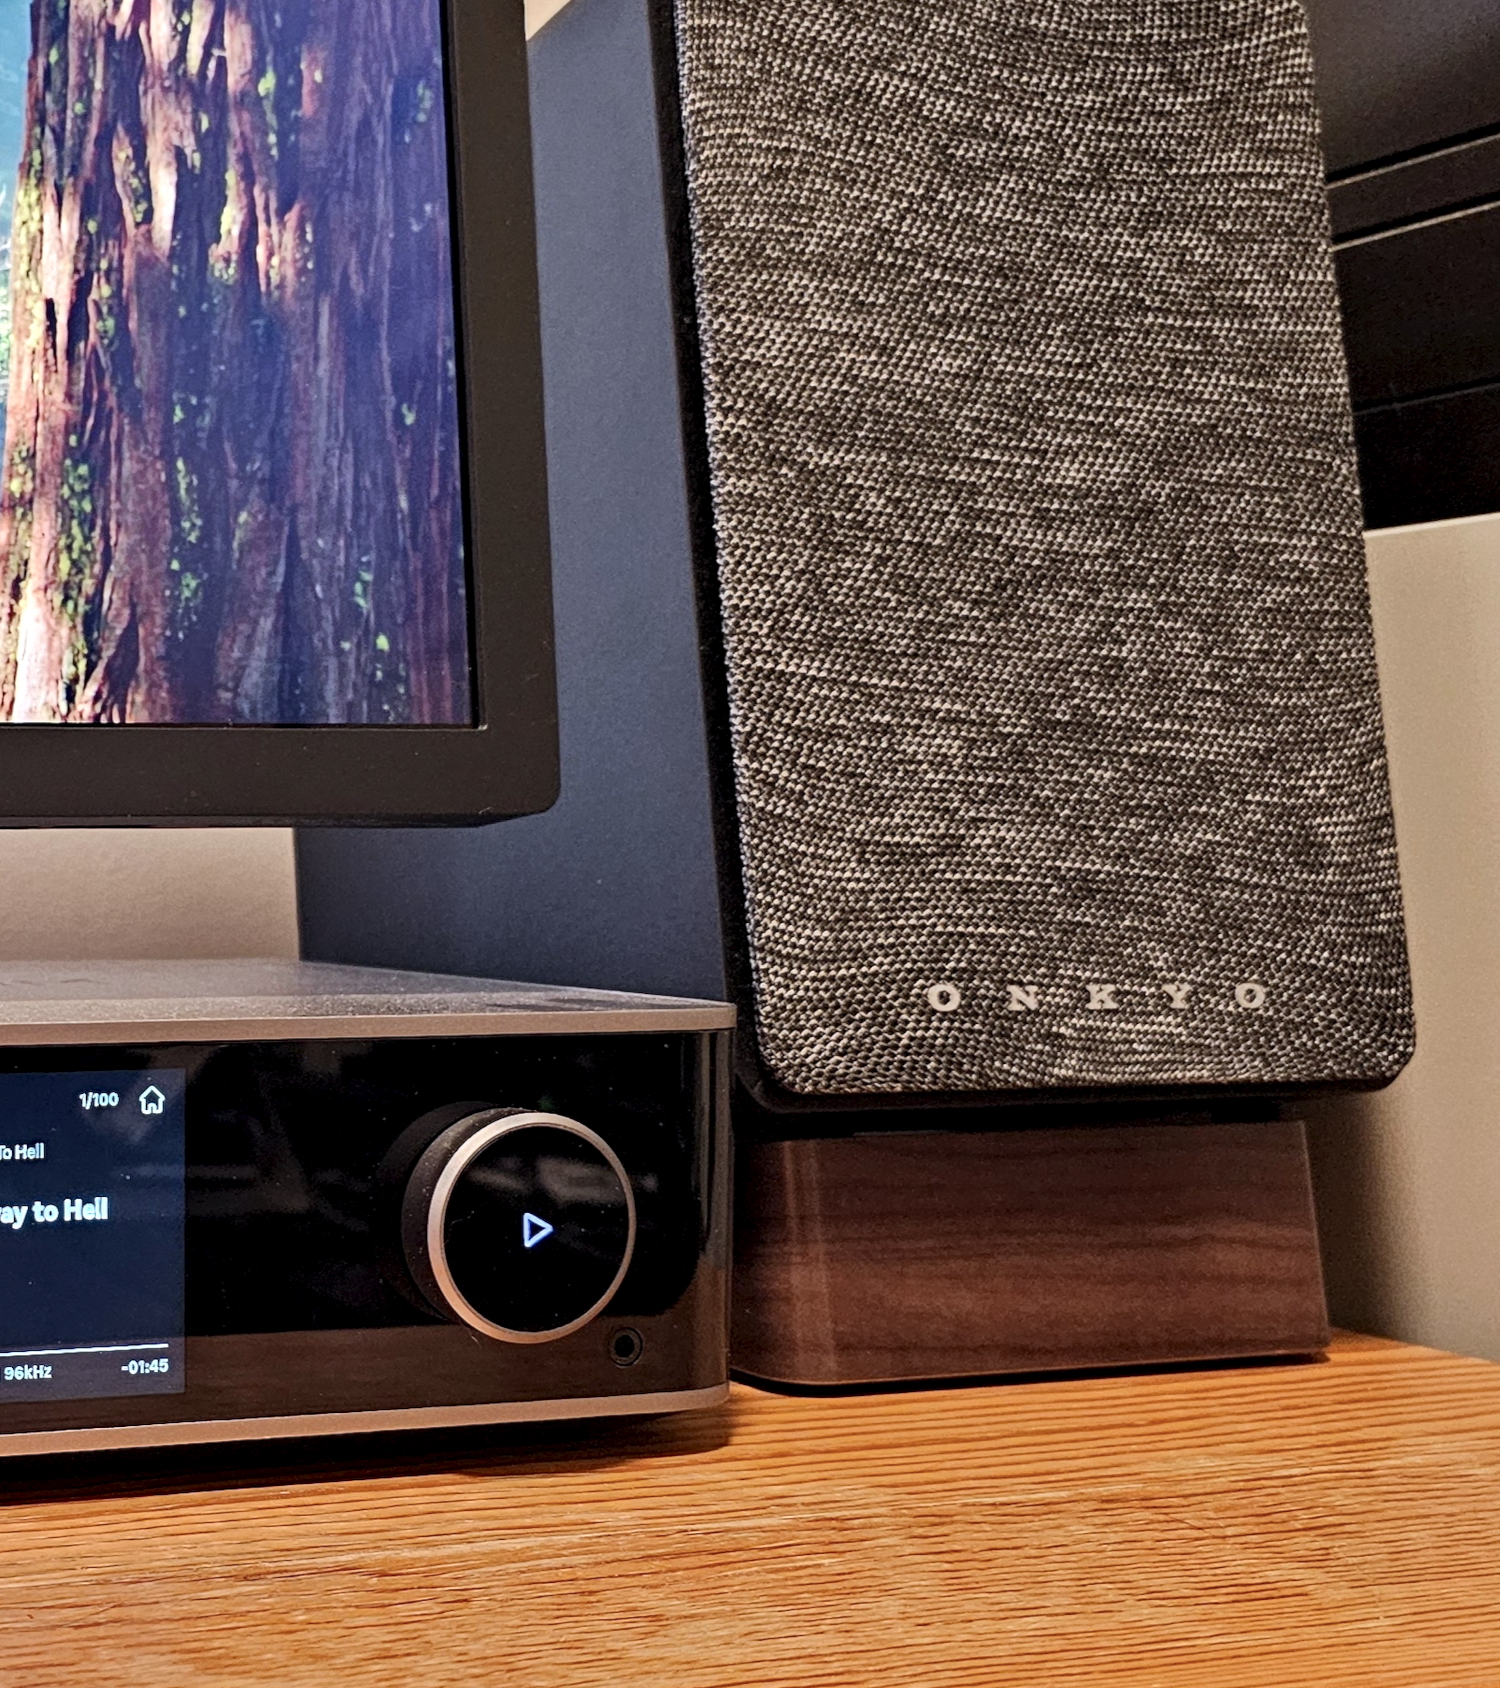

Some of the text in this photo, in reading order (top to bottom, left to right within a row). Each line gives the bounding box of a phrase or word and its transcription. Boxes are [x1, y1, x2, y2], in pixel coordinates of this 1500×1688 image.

[927, 983, 1266, 1012] ONKYO
[79, 1092, 119, 1109] 1/100
[14, 1143, 45, 1160] Hell
[33, 1200, 56, 1224] to
[63, 1197, 108, 1222] Hell
[4, 1364, 52, 1383] 96kHz
[121, 1358, 169, 1376] -01:45
